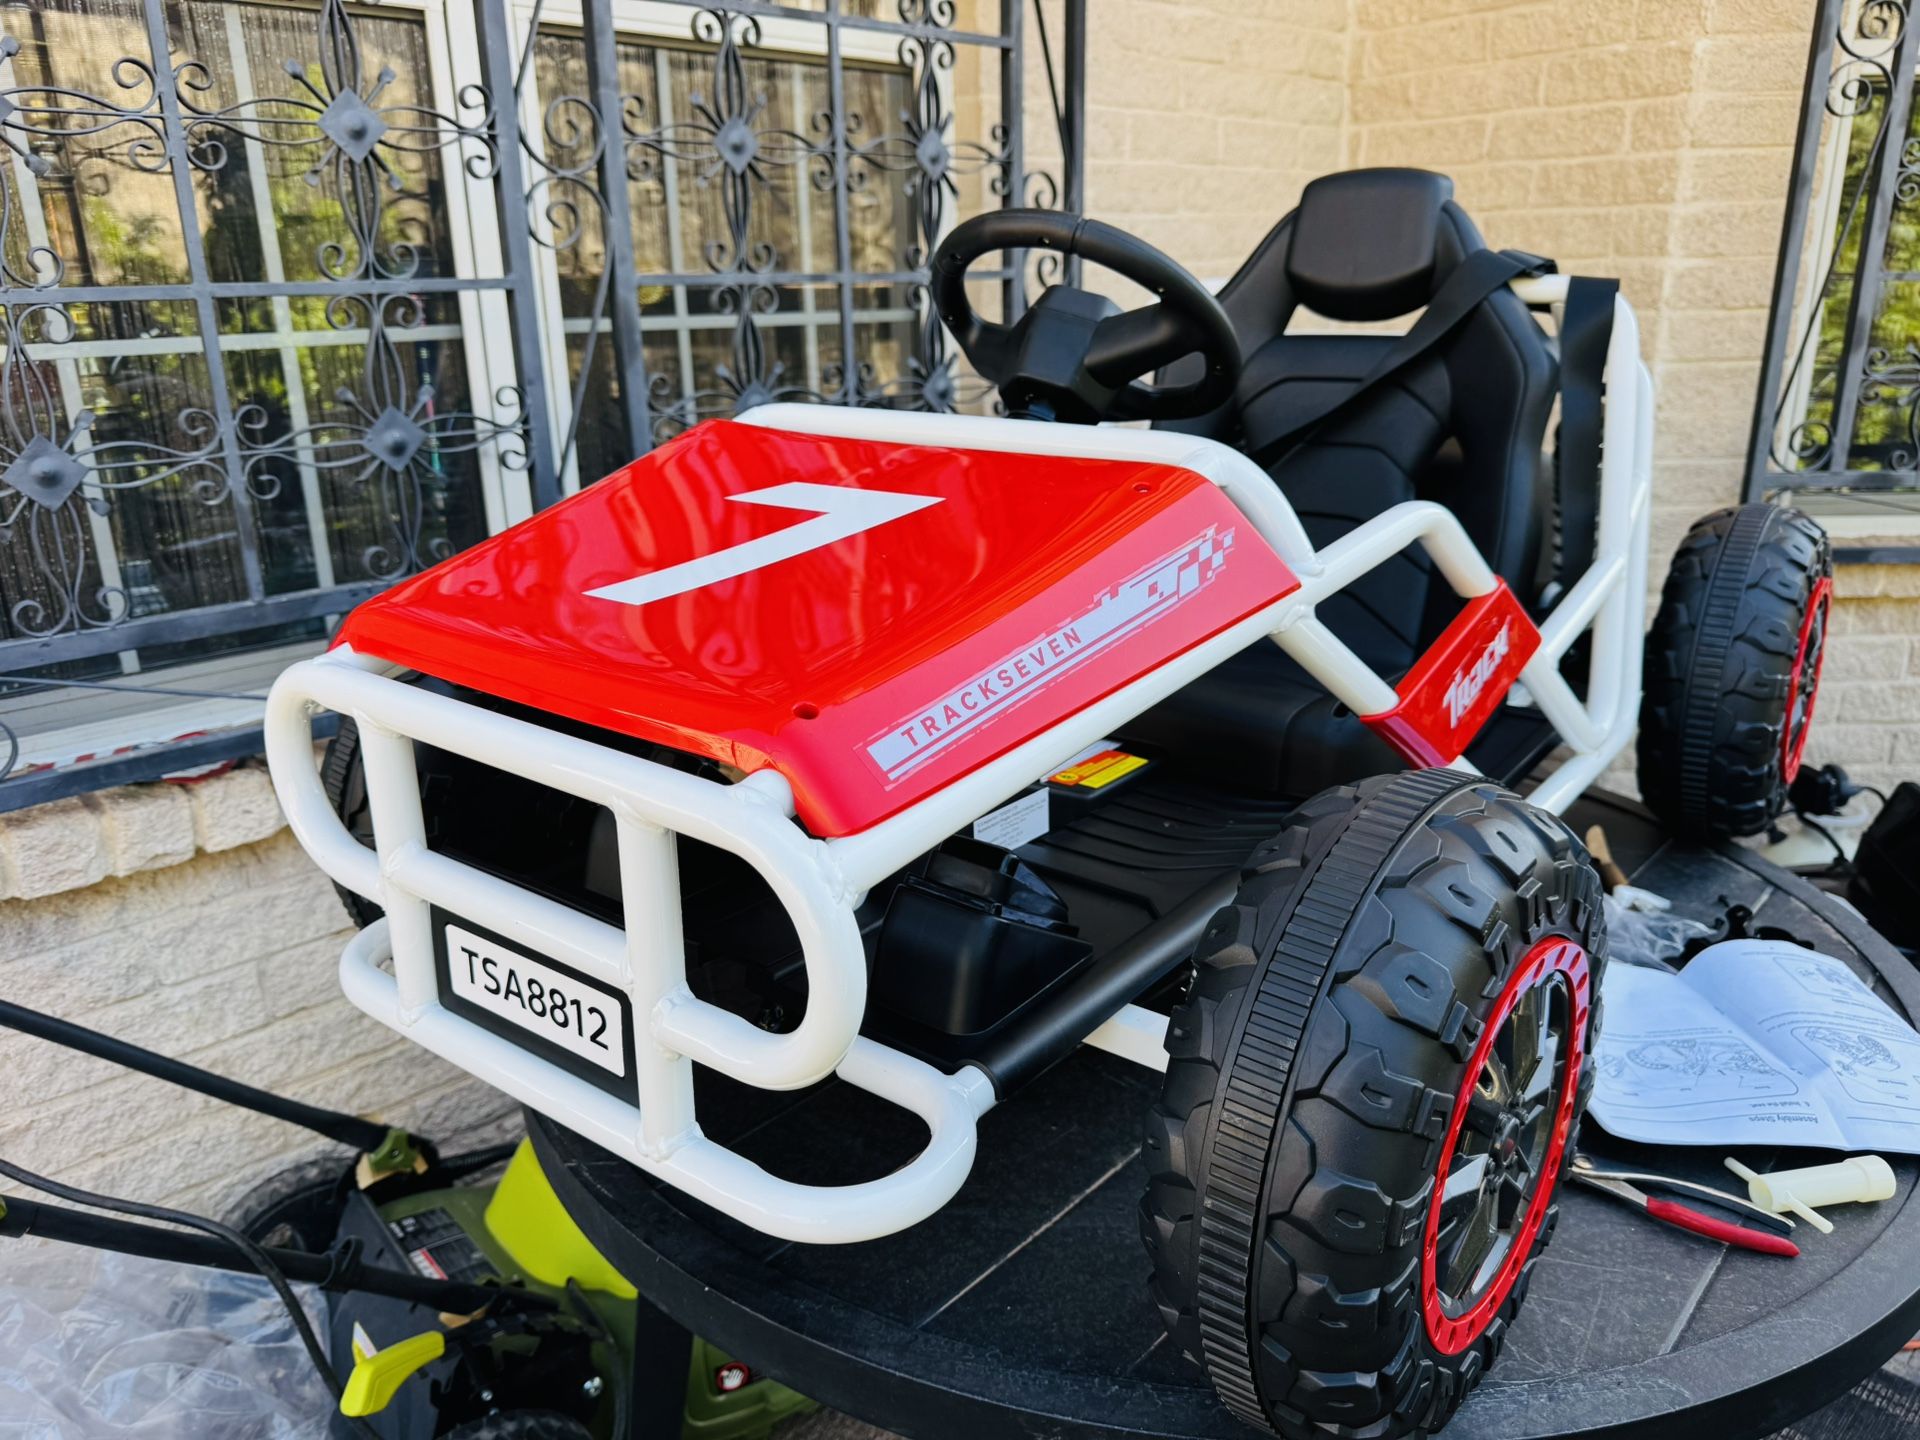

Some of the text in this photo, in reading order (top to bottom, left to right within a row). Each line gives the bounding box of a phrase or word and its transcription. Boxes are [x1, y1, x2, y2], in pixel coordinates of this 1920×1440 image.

[580, 481, 947, 606] 7
[901, 627, 1083, 747] TRACKSEVEN
[460, 946, 609, 1051] TSA8812
[1748, 1114, 1819, 1125] Assembly Steps
